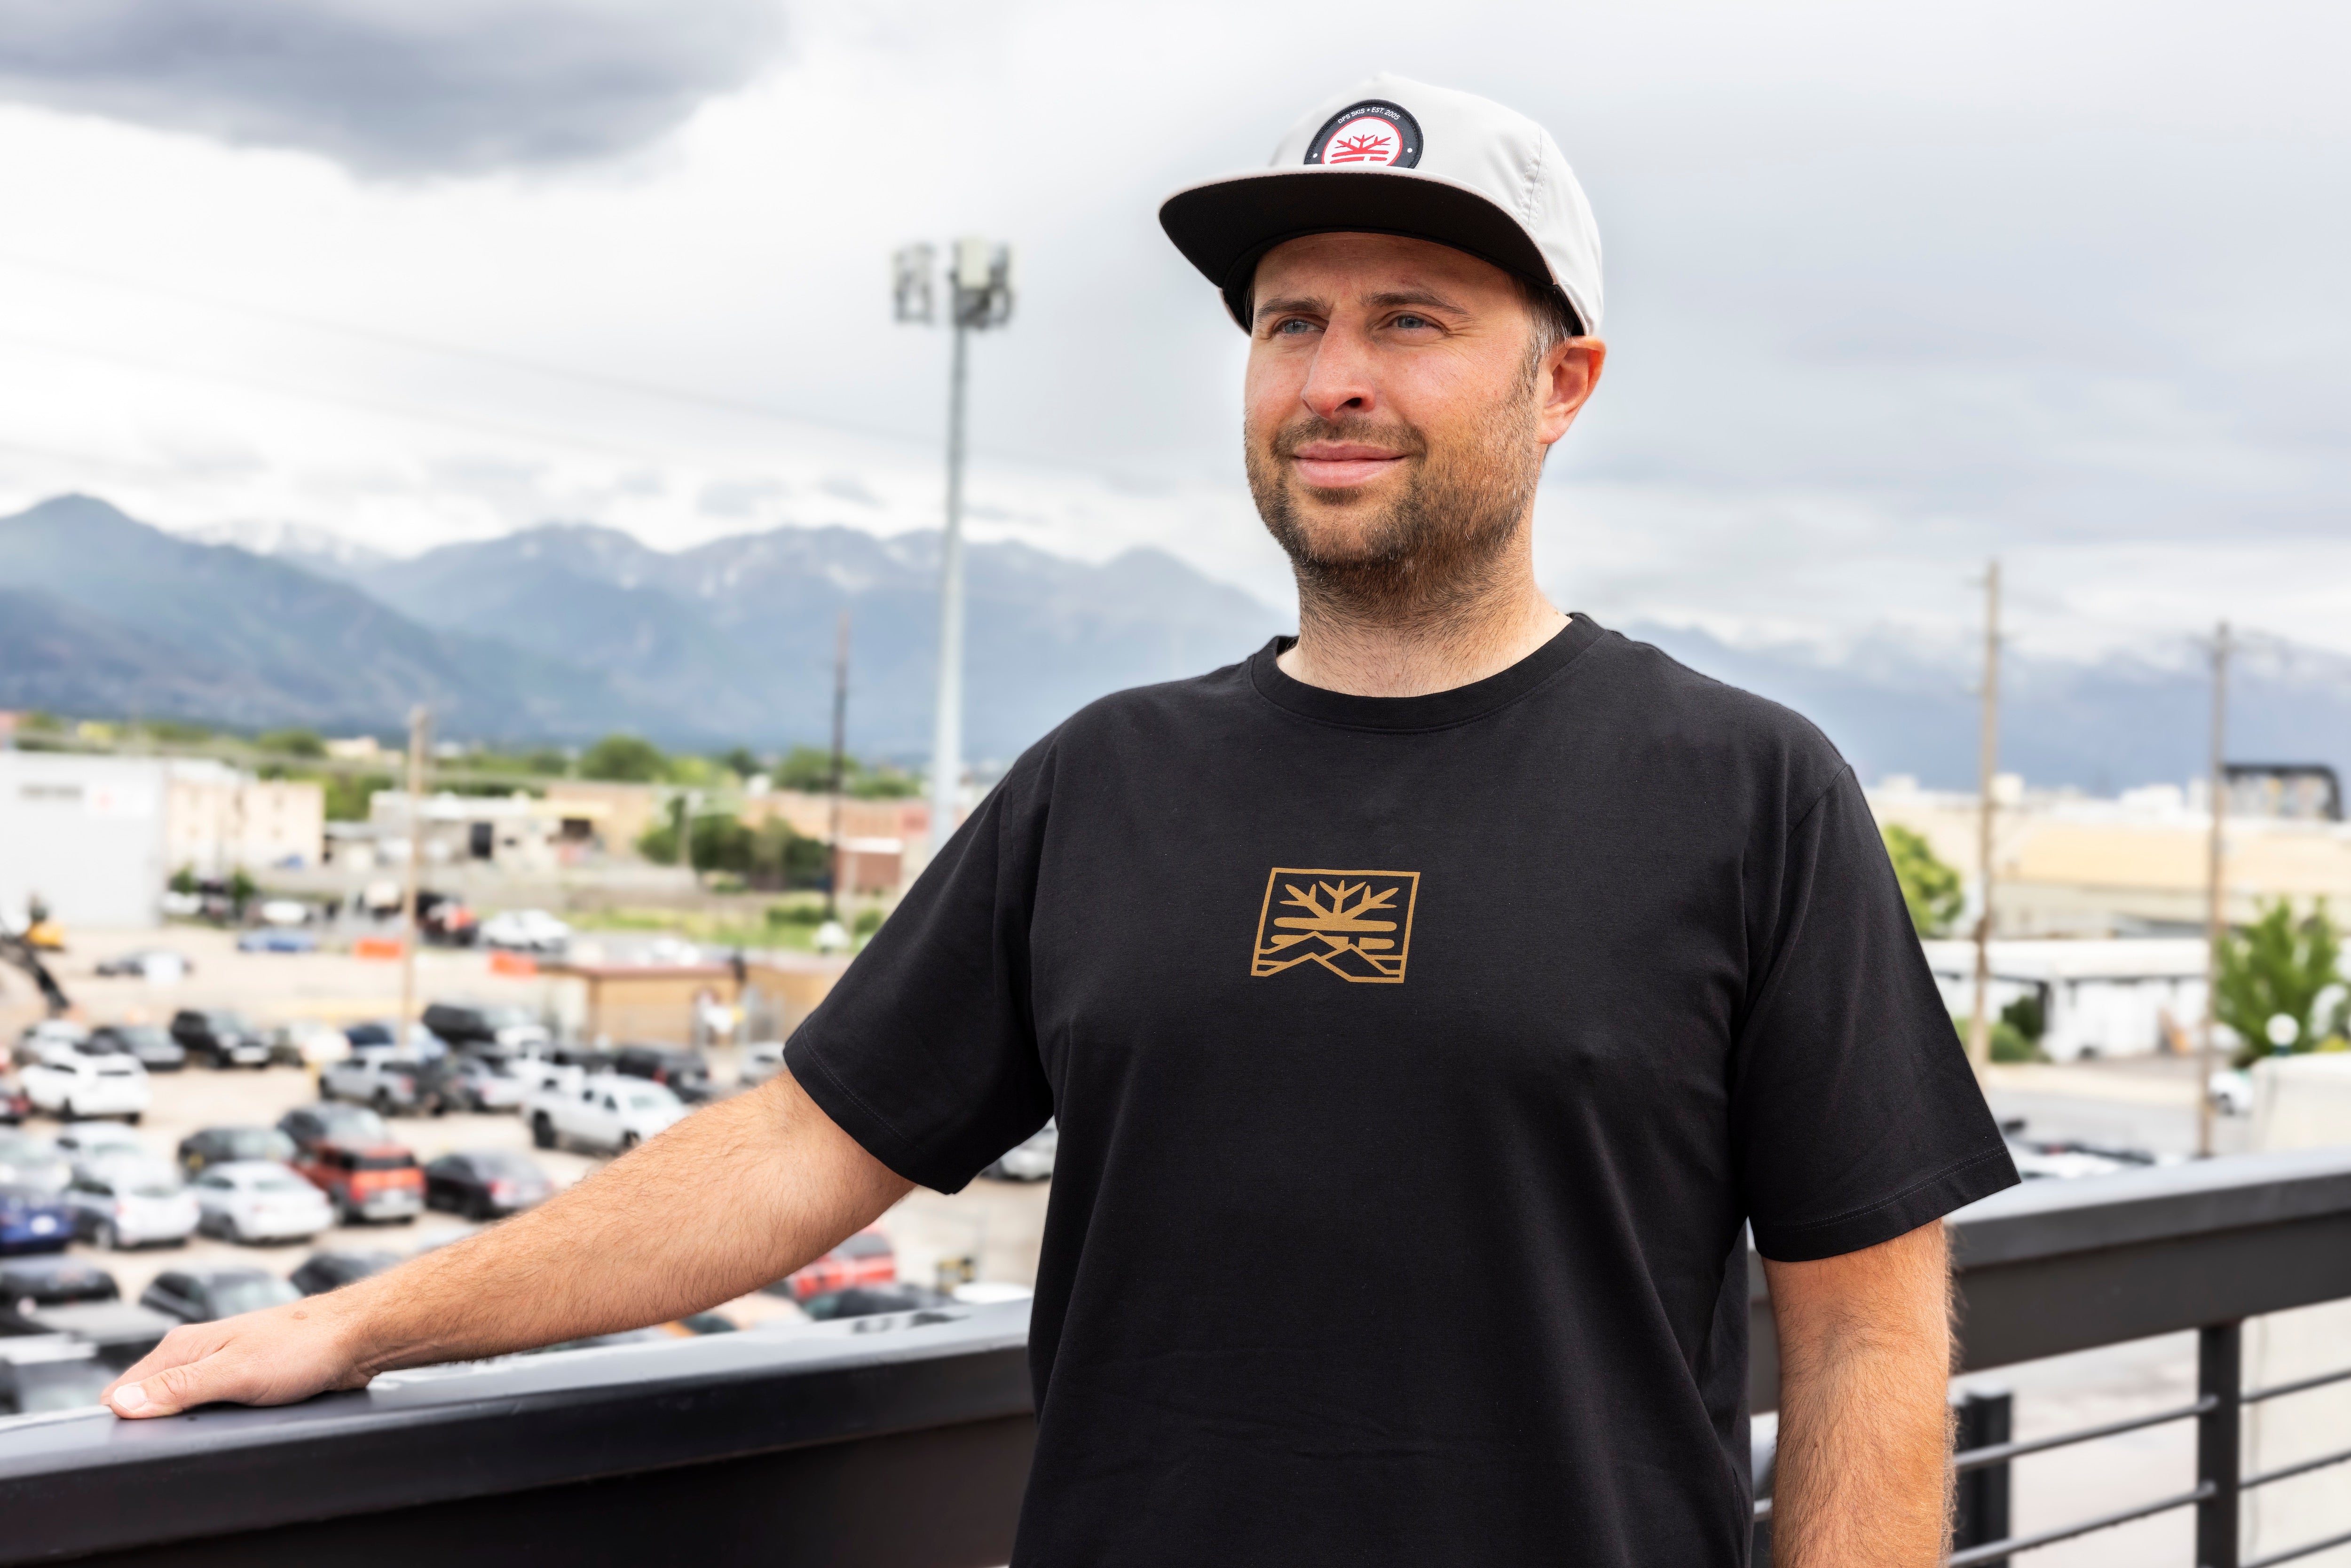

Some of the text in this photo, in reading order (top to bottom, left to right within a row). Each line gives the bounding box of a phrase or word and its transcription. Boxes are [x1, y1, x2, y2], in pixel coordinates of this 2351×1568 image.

[1338, 114, 1350, 124] DPS
[1351, 108, 1365, 117] SKIS
[1384, 110, 1401, 120] 2005
